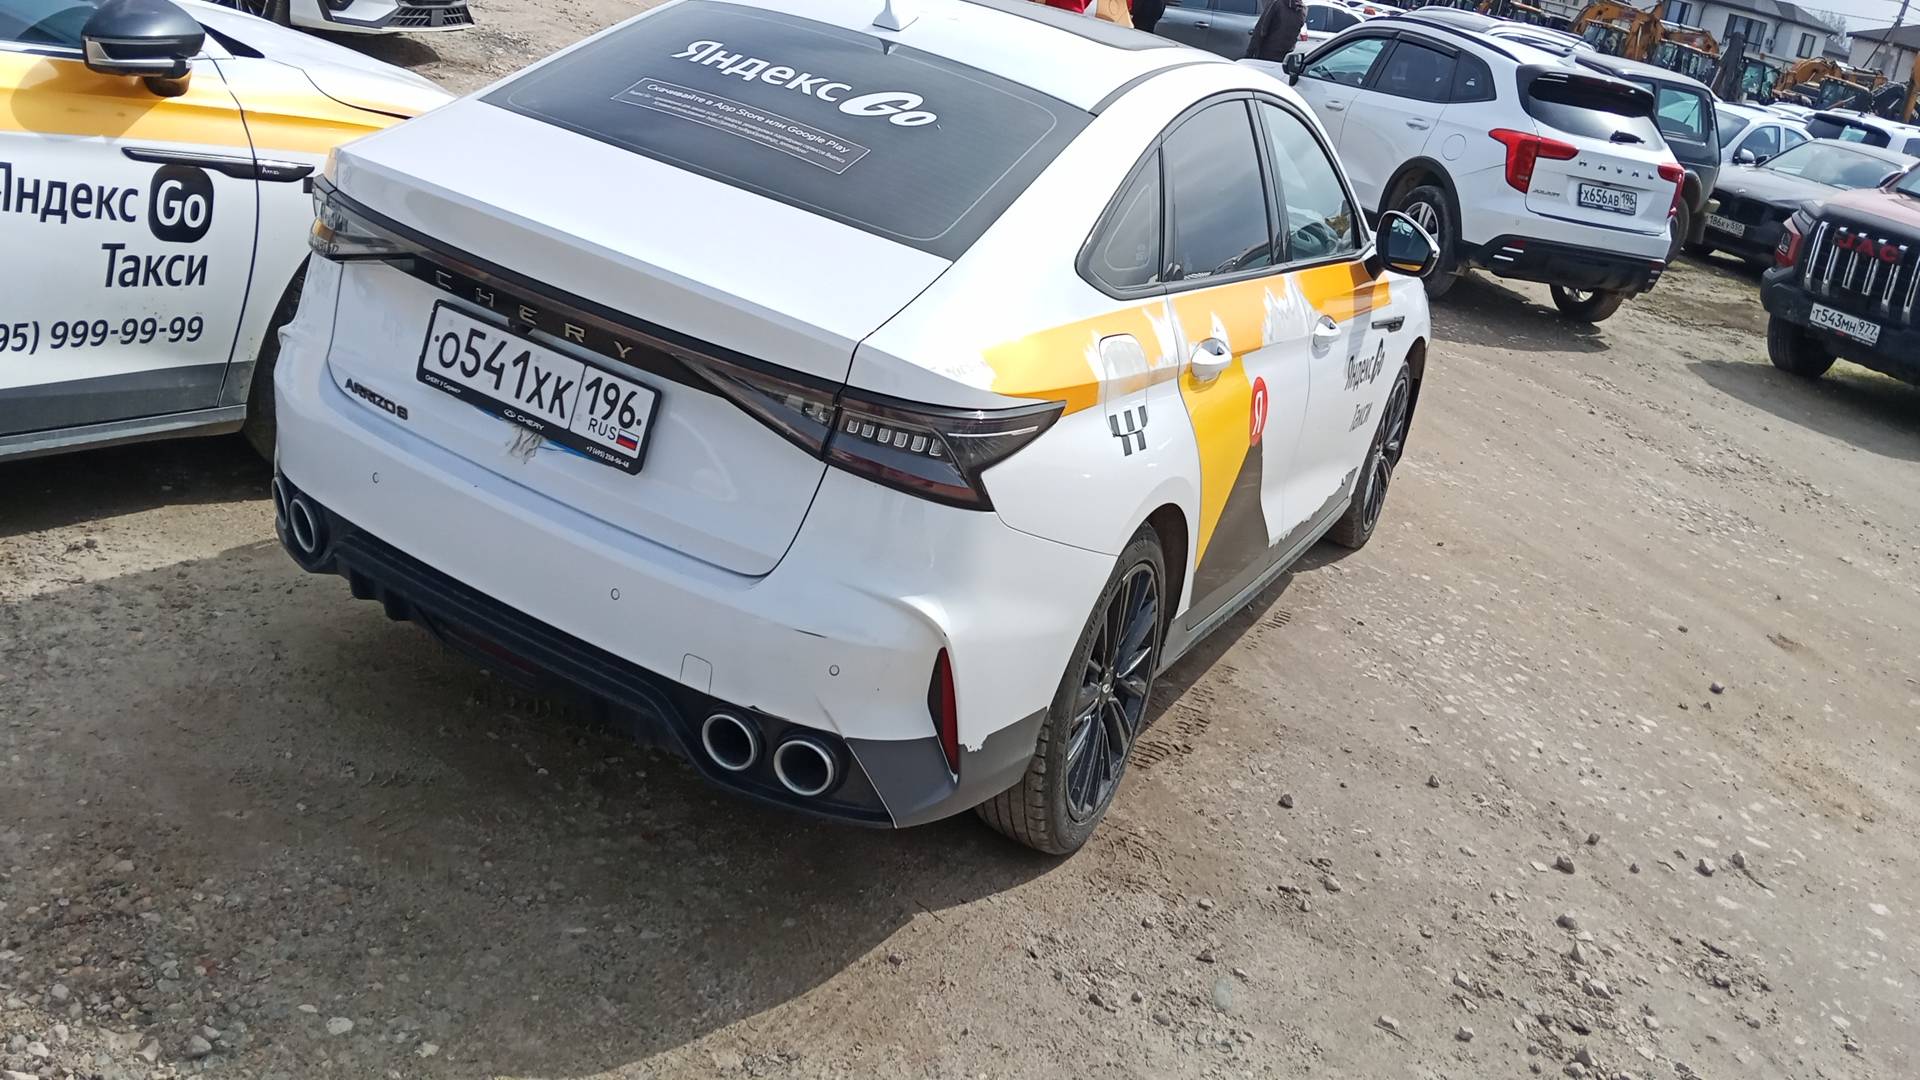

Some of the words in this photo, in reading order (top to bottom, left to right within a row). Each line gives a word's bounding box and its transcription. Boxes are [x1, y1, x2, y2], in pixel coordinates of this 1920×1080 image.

[671, 40, 853, 102] Яндекс
[838, 91, 938, 127] Go
[712, 102, 736, 113] App
[735, 108, 765, 122] Store
[764, 119, 787, 130] или
[787, 125, 826, 144] Google
[825, 139, 851, 154] Play
[156, 179, 206, 228] Go
[101, 242, 208, 288] Такси
[1838, 231, 1899, 262] JAC
[50, 315, 204, 349] 999-99-99
[435, 269, 633, 359] CHERY
[1859, 321, 1878, 336] 977
[1344, 354, 1375, 392] Яндекс
[516, 414, 545, 431] CHERY
[585, 376, 639, 429] 196
[587, 417, 617, 441] RUS
